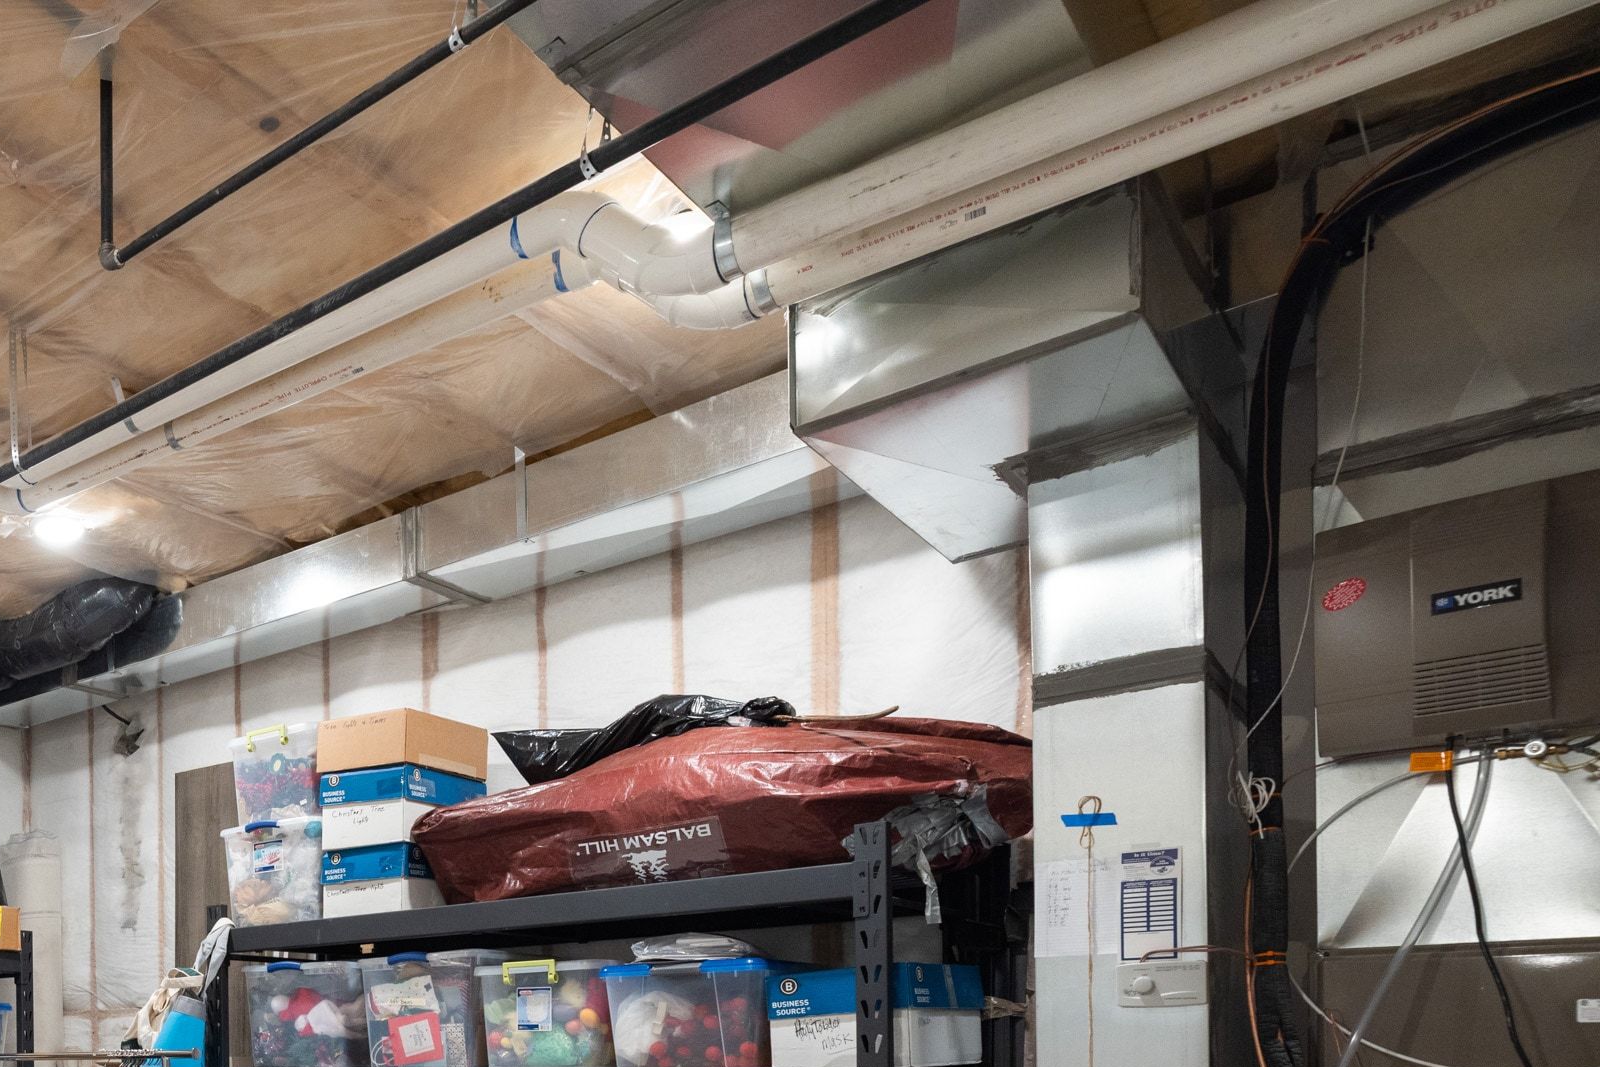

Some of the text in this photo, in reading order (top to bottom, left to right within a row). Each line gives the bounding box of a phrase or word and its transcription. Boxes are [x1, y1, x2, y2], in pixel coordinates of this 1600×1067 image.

[1453, 585, 1515, 606] YORK
[322, 789, 345, 798] BUSINESS
[578, 823, 713, 856] BALSAM HILL
[324, 868, 346, 876] BUSINESS
[772, 998, 810, 1009] BUSINESS
